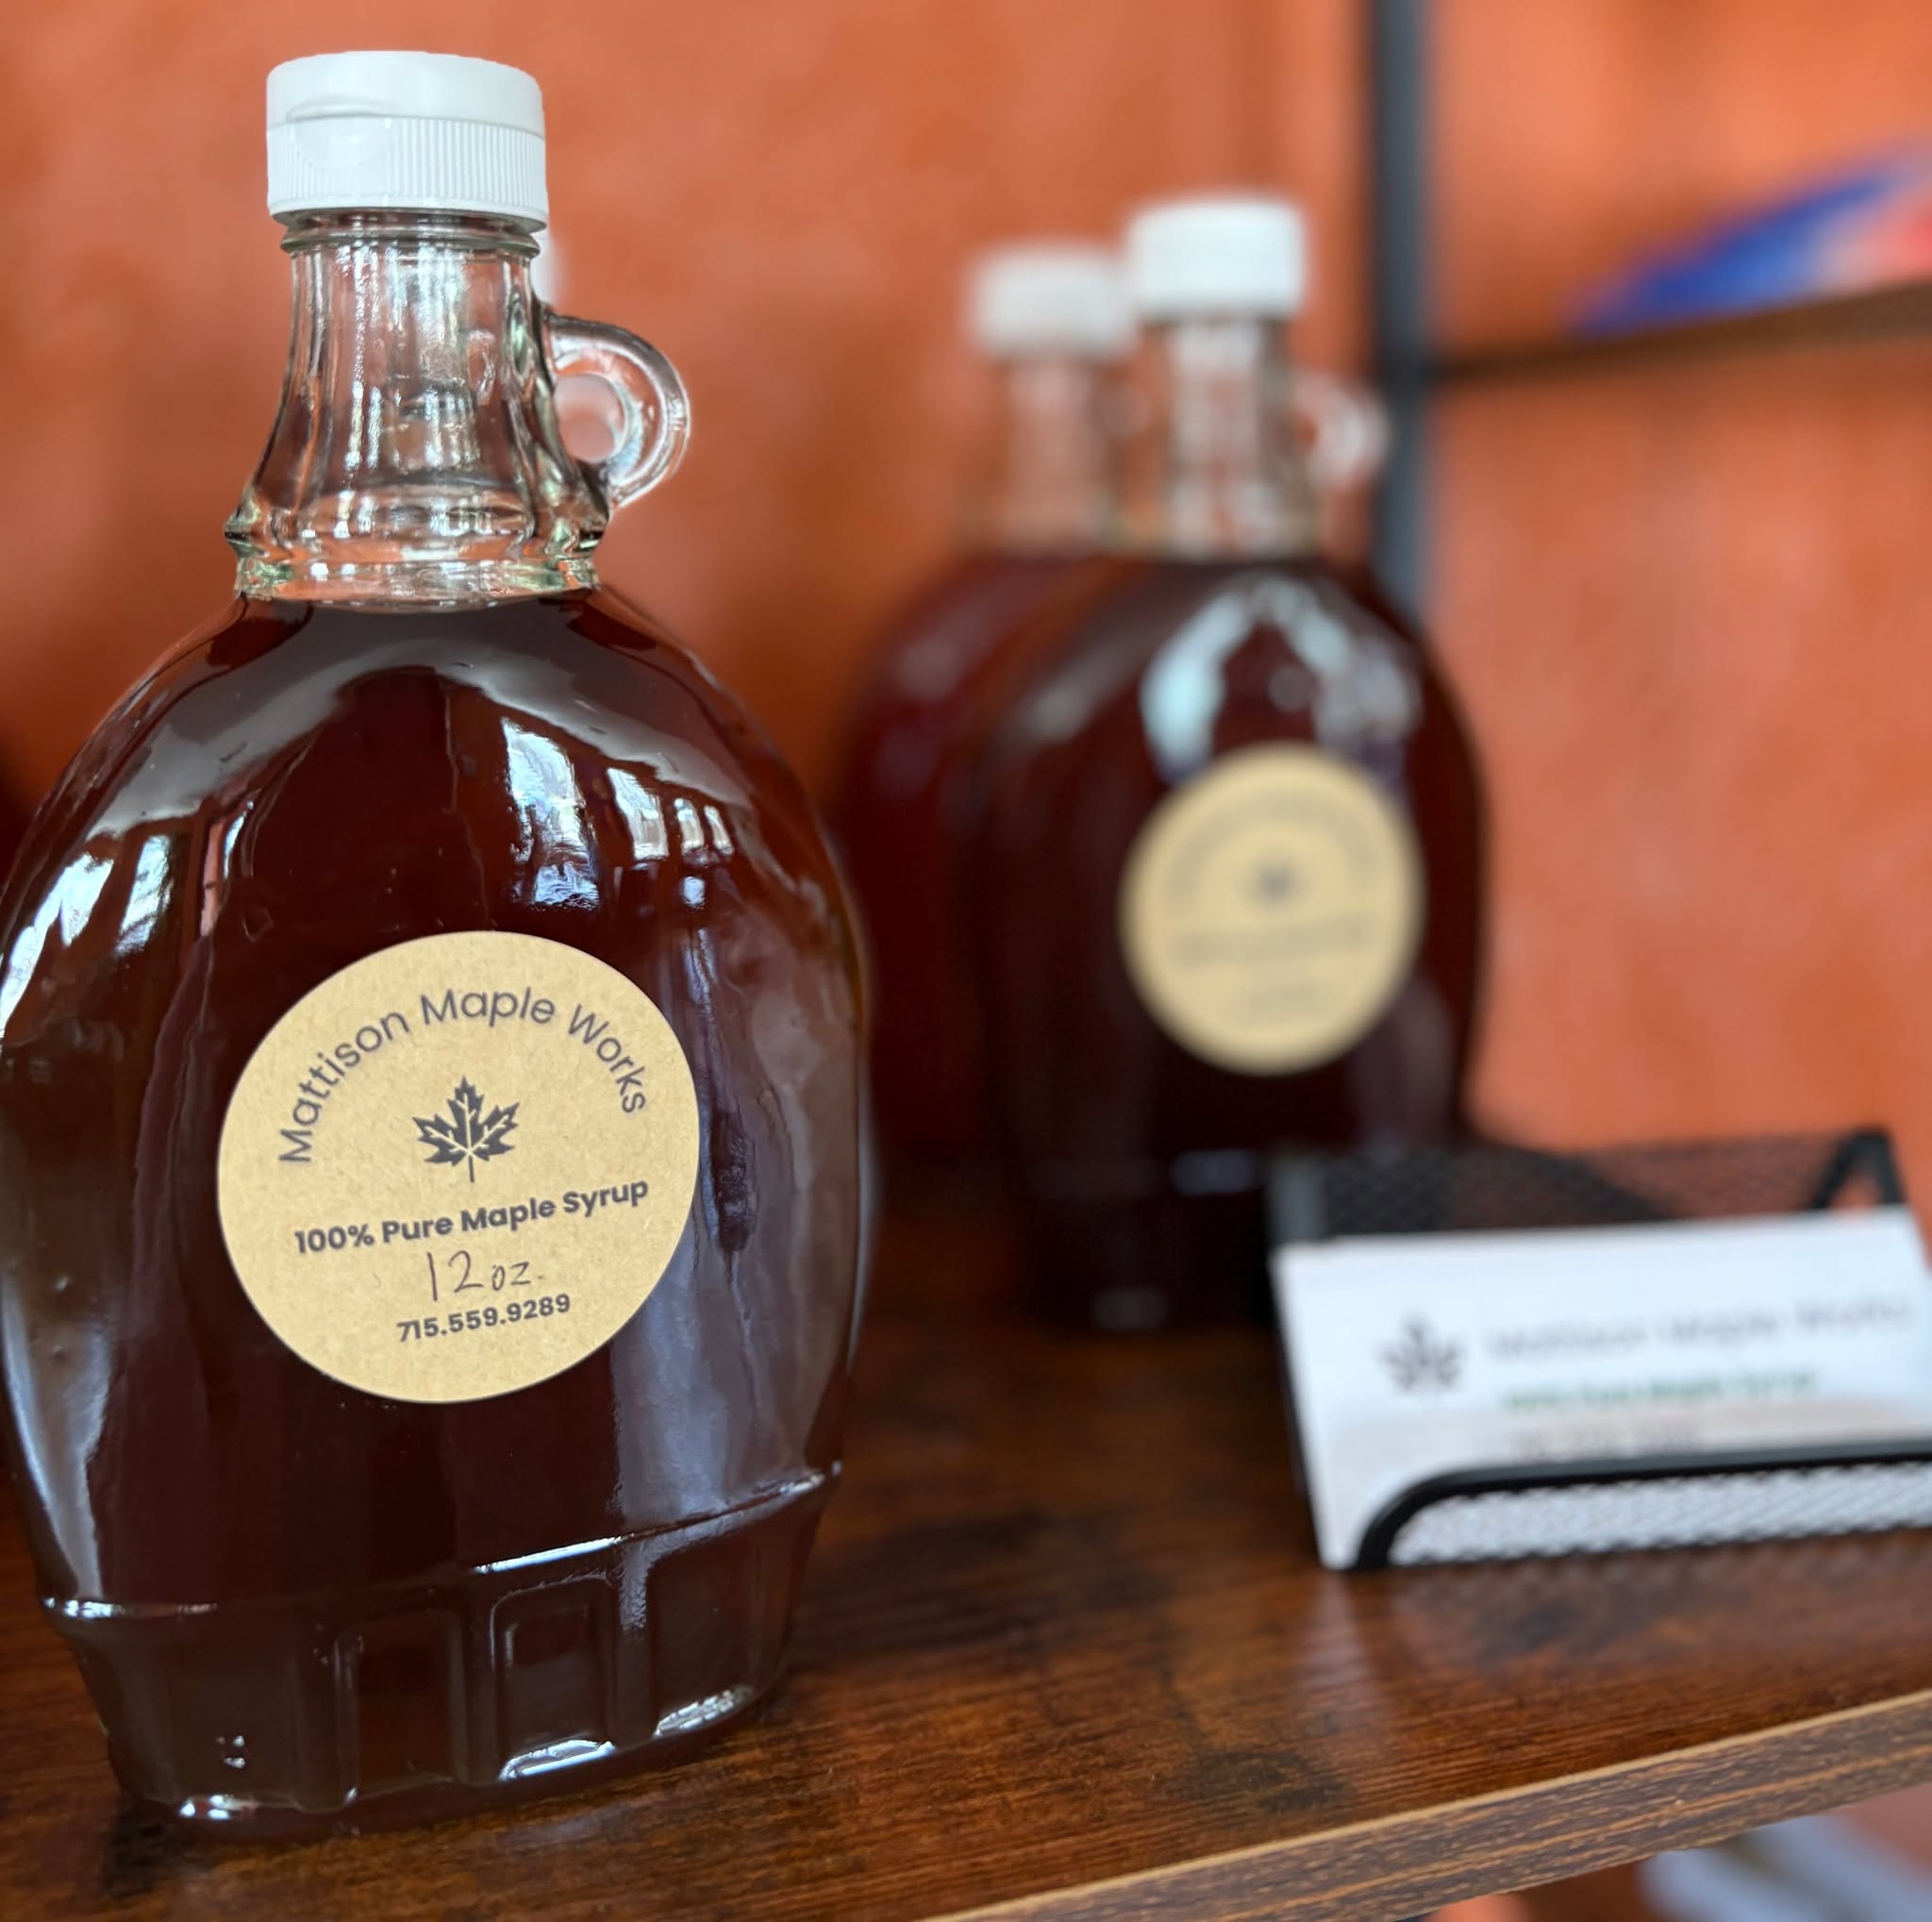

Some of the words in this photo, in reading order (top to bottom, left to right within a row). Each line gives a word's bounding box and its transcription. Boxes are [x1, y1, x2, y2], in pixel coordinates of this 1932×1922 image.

[279, 1011, 409, 1163] Mattison
[421, 987, 556, 1027] Maple
[568, 1004, 647, 1114] Works
[294, 1226, 375, 1253] 100%
[383, 1216, 454, 1243] Pure
[461, 1198, 557, 1238] Maple
[563, 1180, 649, 1215] Syrup
[397, 1295, 571, 1342] 715.559.9289
